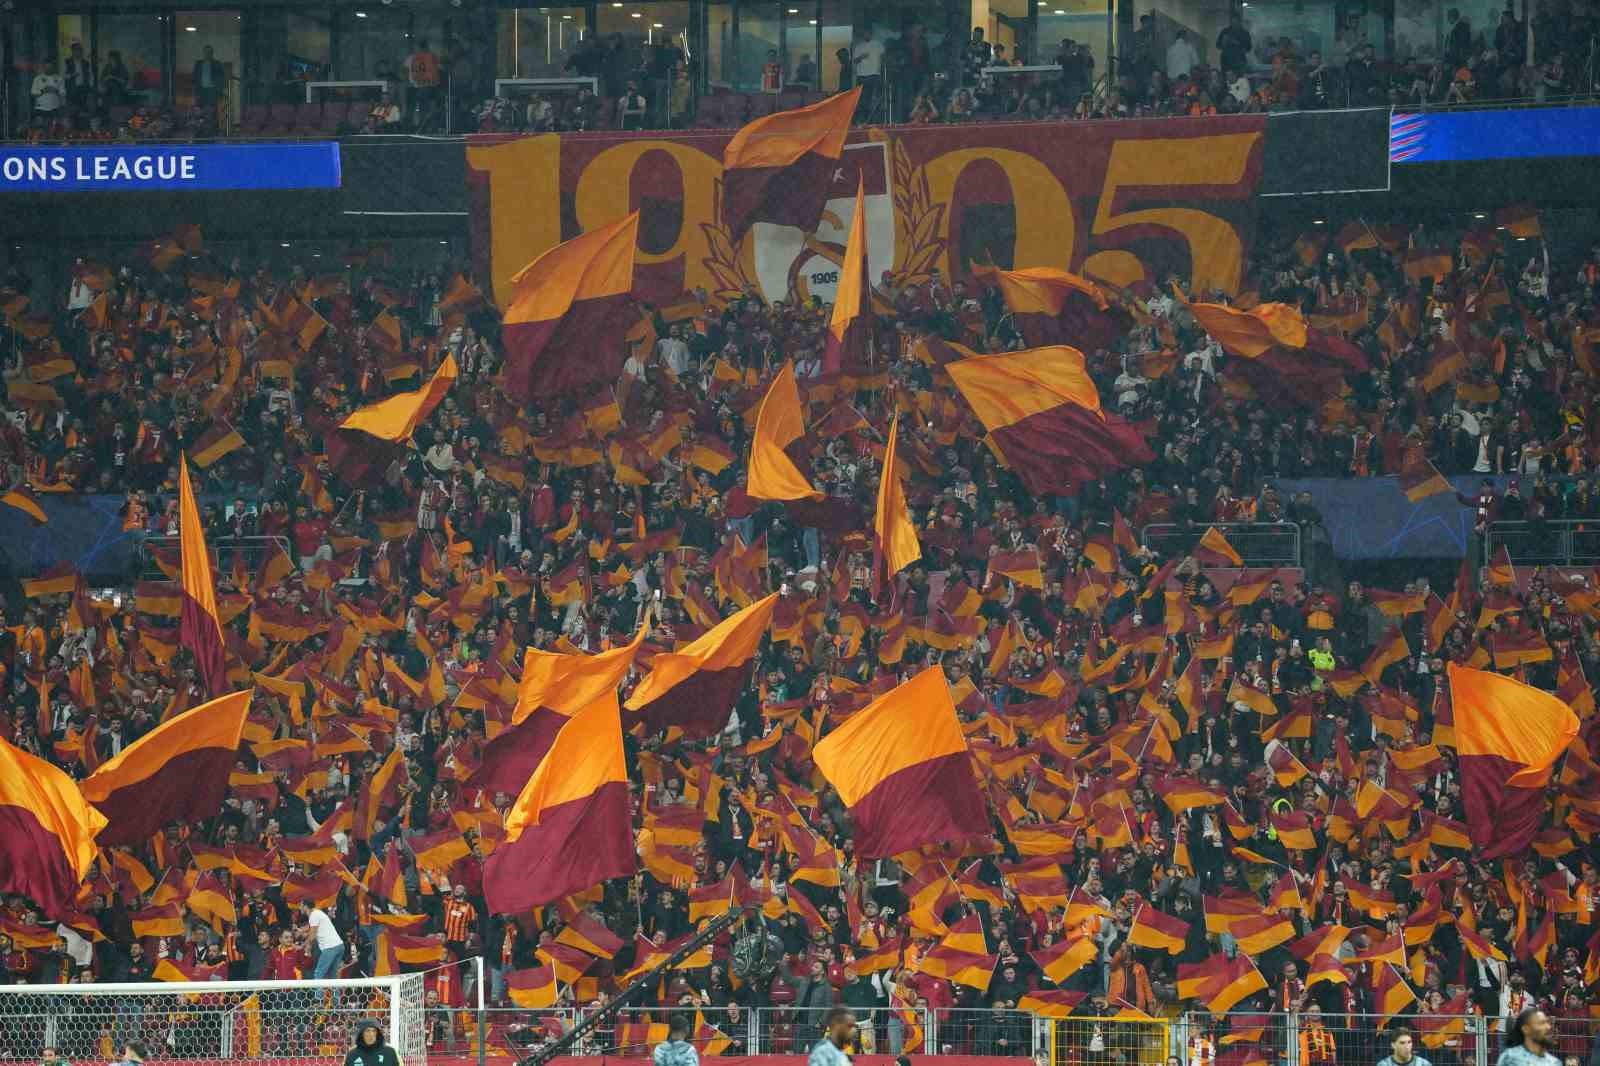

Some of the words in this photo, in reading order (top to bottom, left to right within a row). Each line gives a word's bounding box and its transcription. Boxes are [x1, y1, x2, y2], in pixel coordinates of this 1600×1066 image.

[3, 157, 66, 180] ONS
[76, 156, 196, 180] LEAGUE
[466, 131, 1262, 310] 1905
[810, 271, 838, 285] 1905
